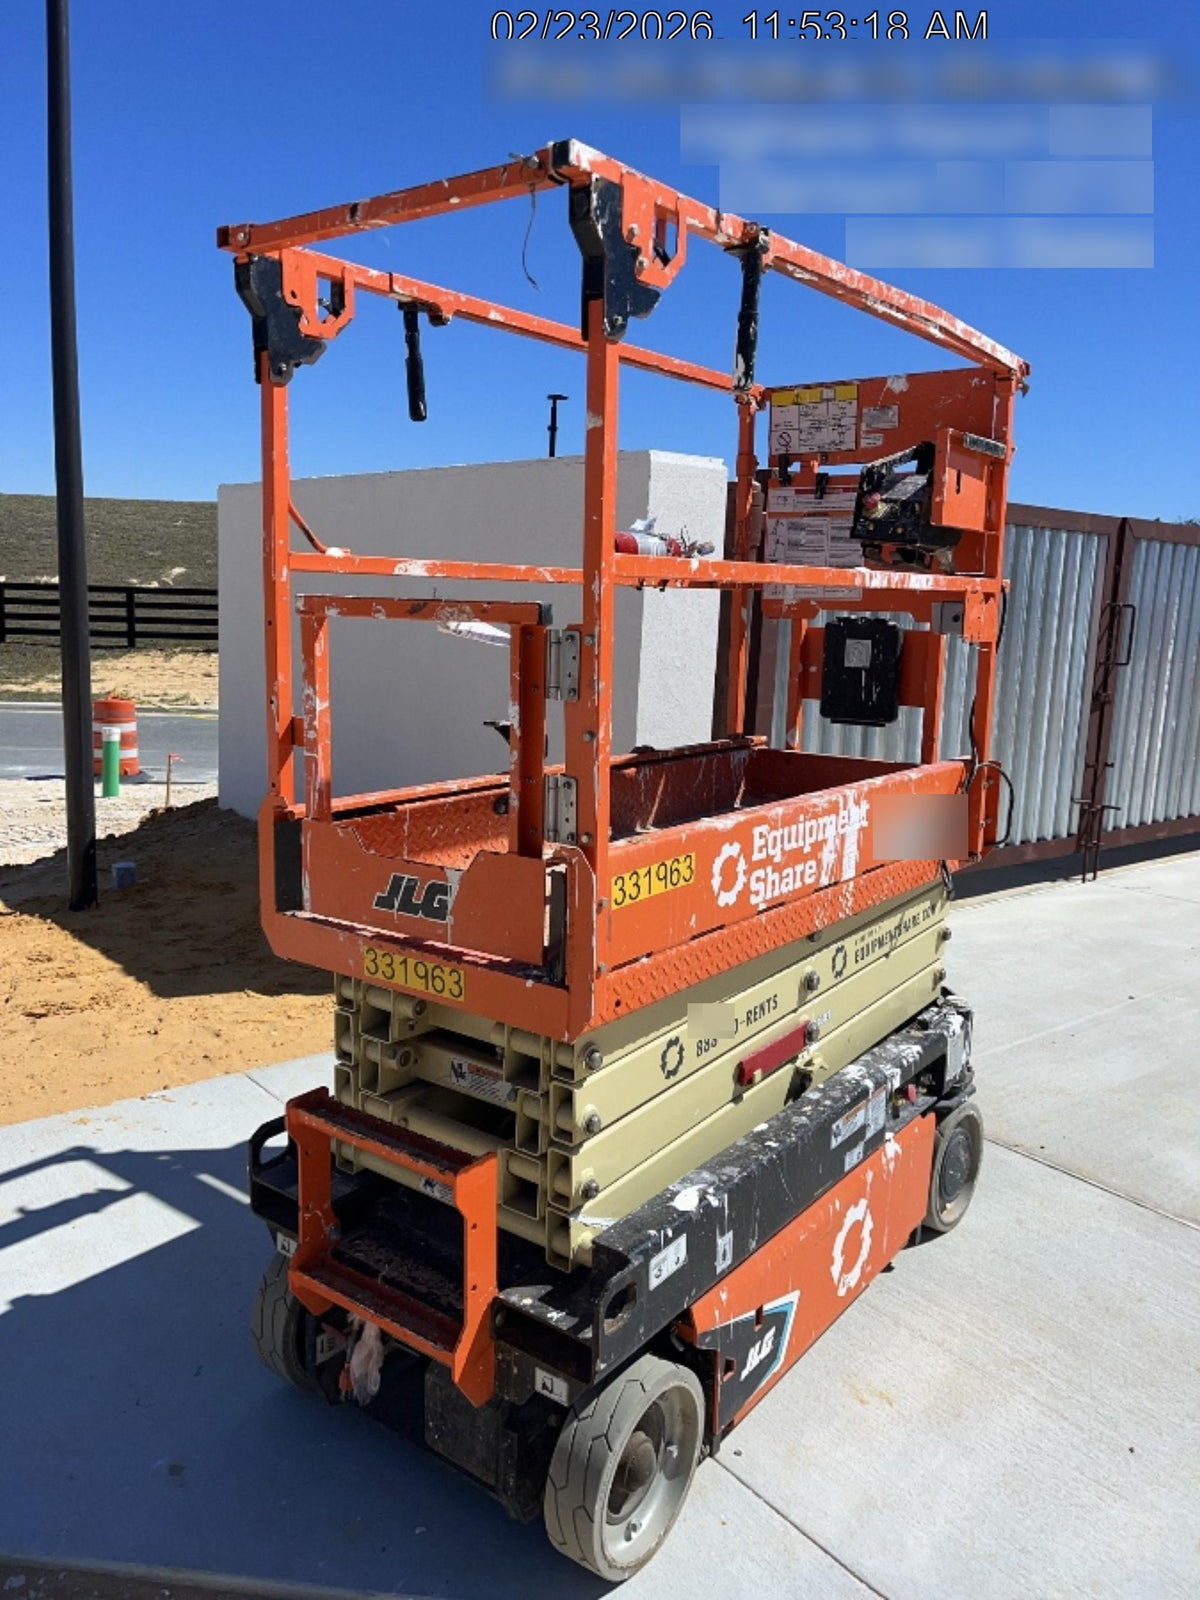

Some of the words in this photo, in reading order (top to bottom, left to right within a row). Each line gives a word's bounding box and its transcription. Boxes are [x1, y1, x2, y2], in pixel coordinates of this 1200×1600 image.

[372, 872, 454, 923] JLG
[613, 854, 694, 906] 331963
[750, 859, 817, 905] Share
[365, 948, 463, 998] 331963
[740, 1325, 776, 1381] JLG
